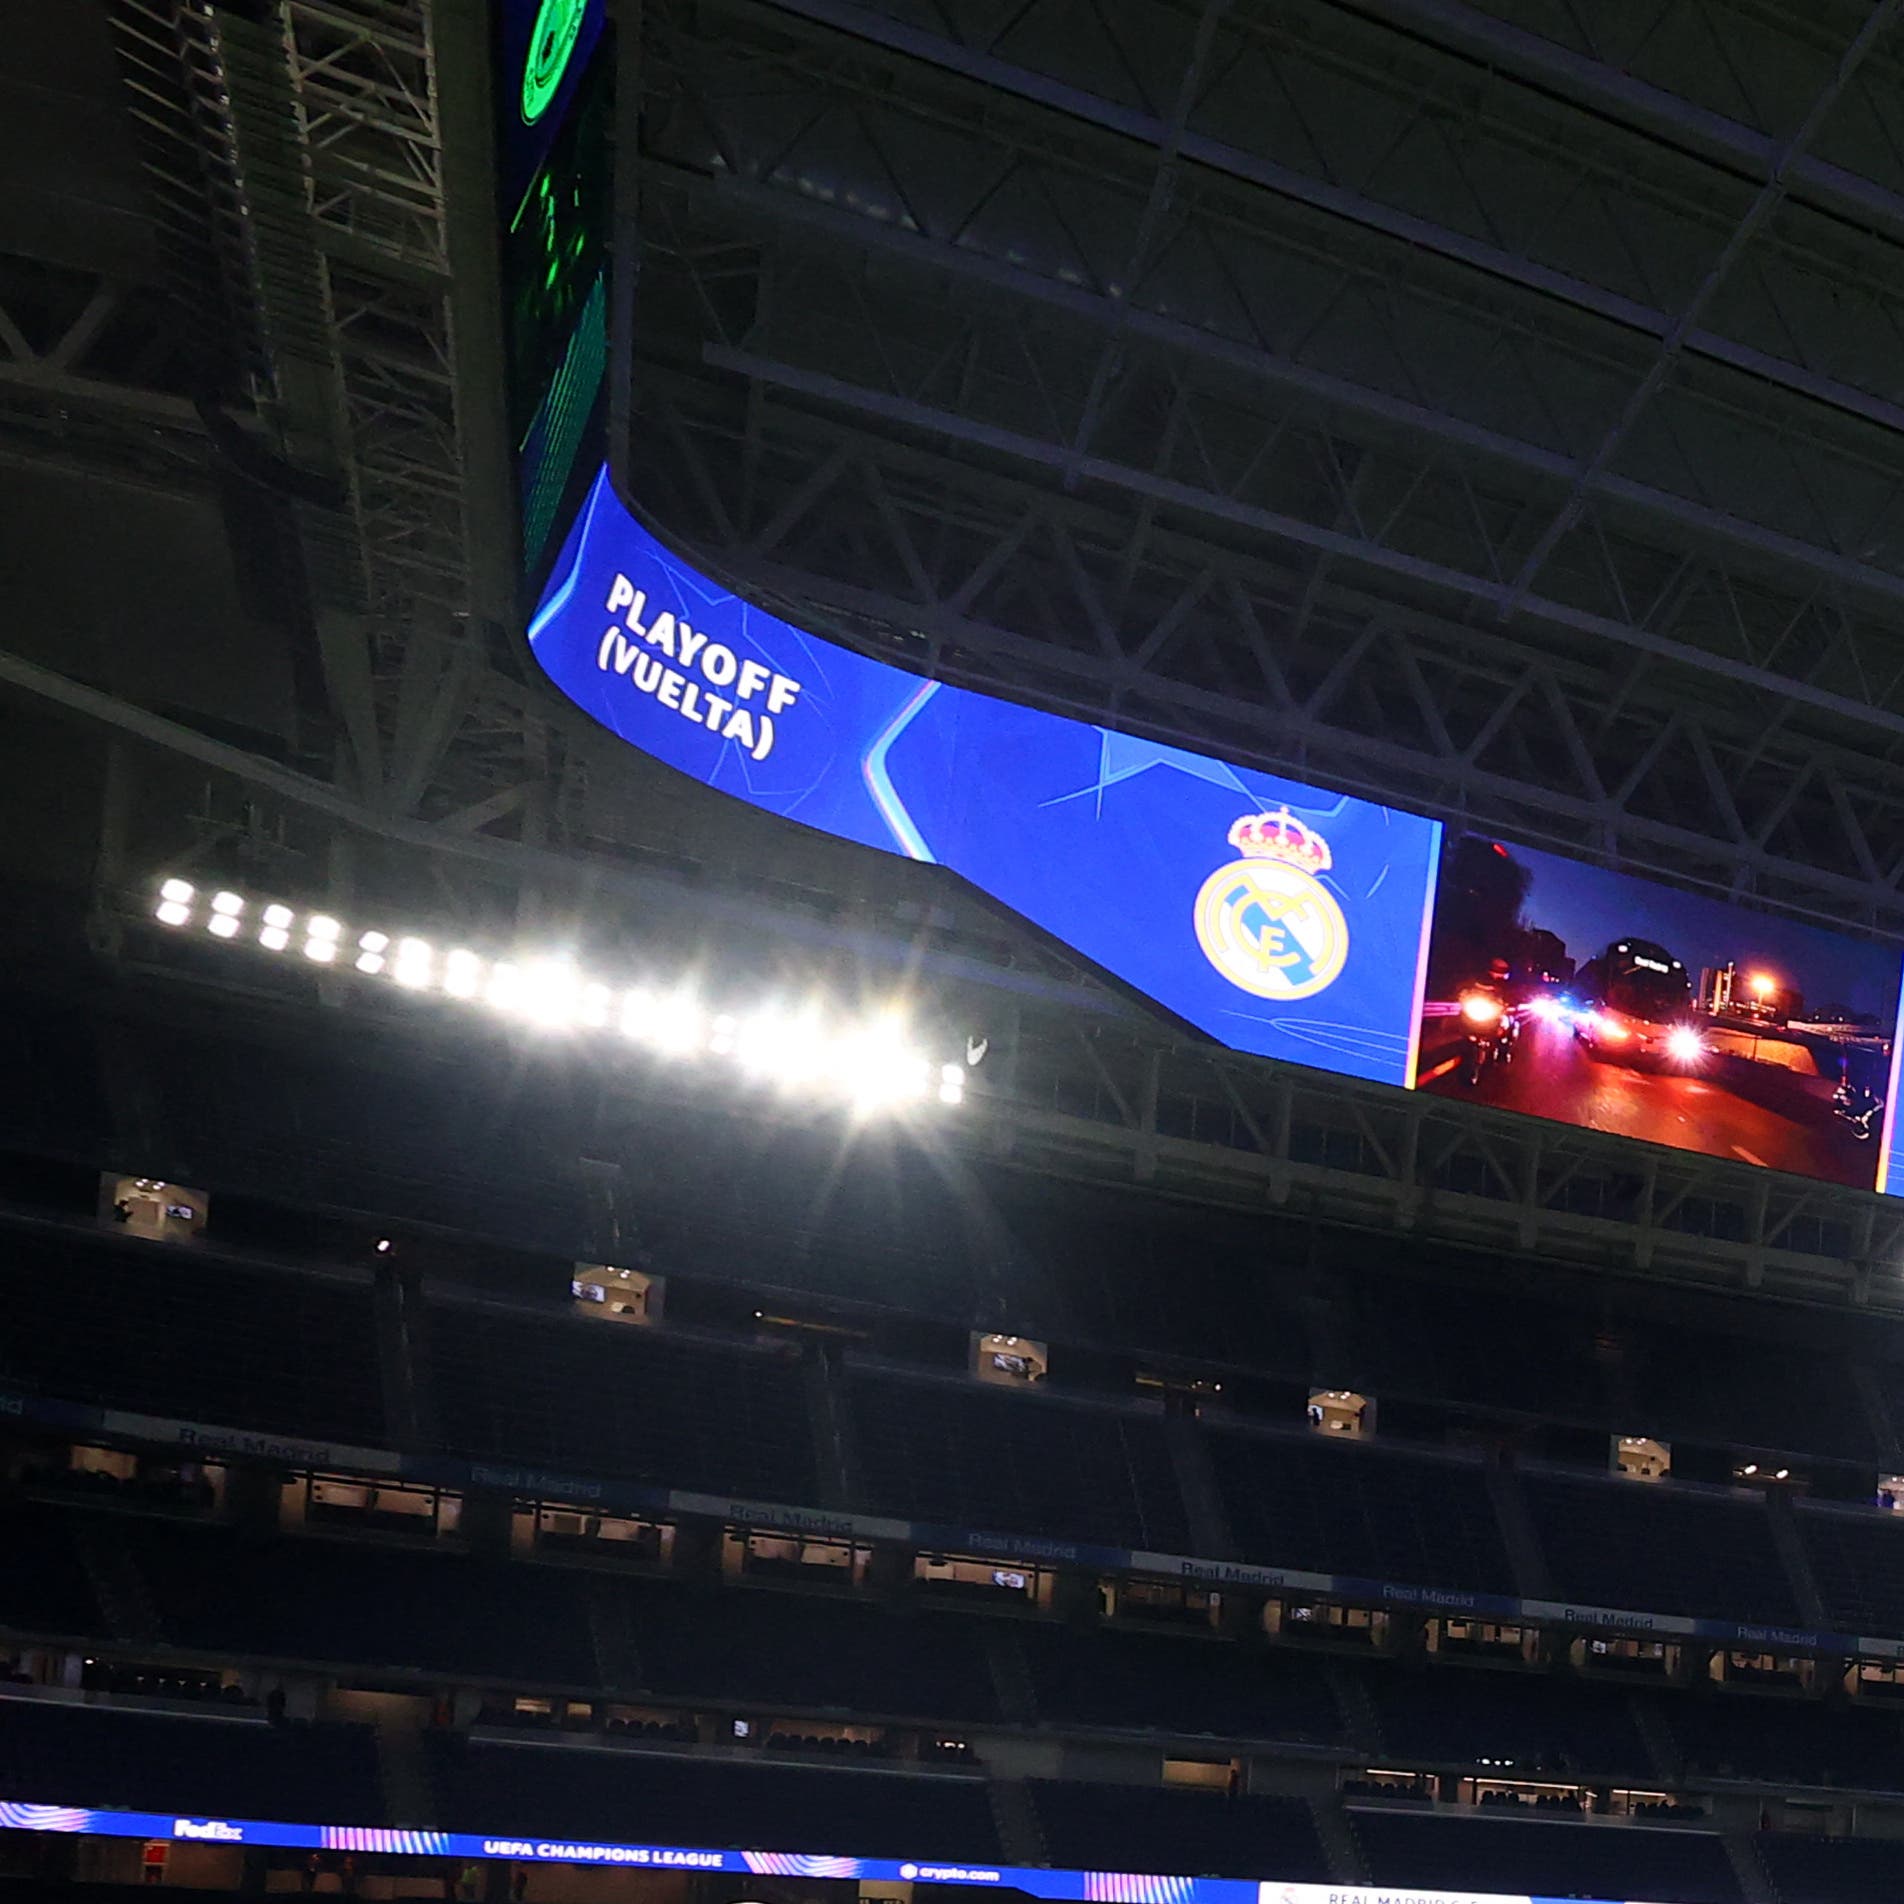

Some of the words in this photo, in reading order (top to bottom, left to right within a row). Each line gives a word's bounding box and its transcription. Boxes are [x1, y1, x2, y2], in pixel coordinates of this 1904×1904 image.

[605, 573, 801, 712] PLAYOFF
[599, 625, 774, 761] (VUELTA)
[968, 1532, 1007, 1548] Real
[1014, 1538, 1076, 1558] Madrid
[1182, 1562, 1219, 1579] Real
[1224, 1567, 1284, 1586] Madrid
[1382, 1586, 1418, 1603] Real
[1422, 1590, 1475, 1607] Madrid
[1564, 1609, 1597, 1624] Real
[1602, 1612, 1653, 1631] Madrid
[1737, 1627, 1767, 1642] Real
[1770, 1630, 1817, 1648] Madrid
[174, 1819, 243, 1841] FedEx
[484, 1840, 534, 1856] UEFA
[537, 1844, 650, 1862] CHAMPIONS
[653, 1850, 723, 1867] LEAGUE
[919, 1867, 1000, 1883] crypto.com
